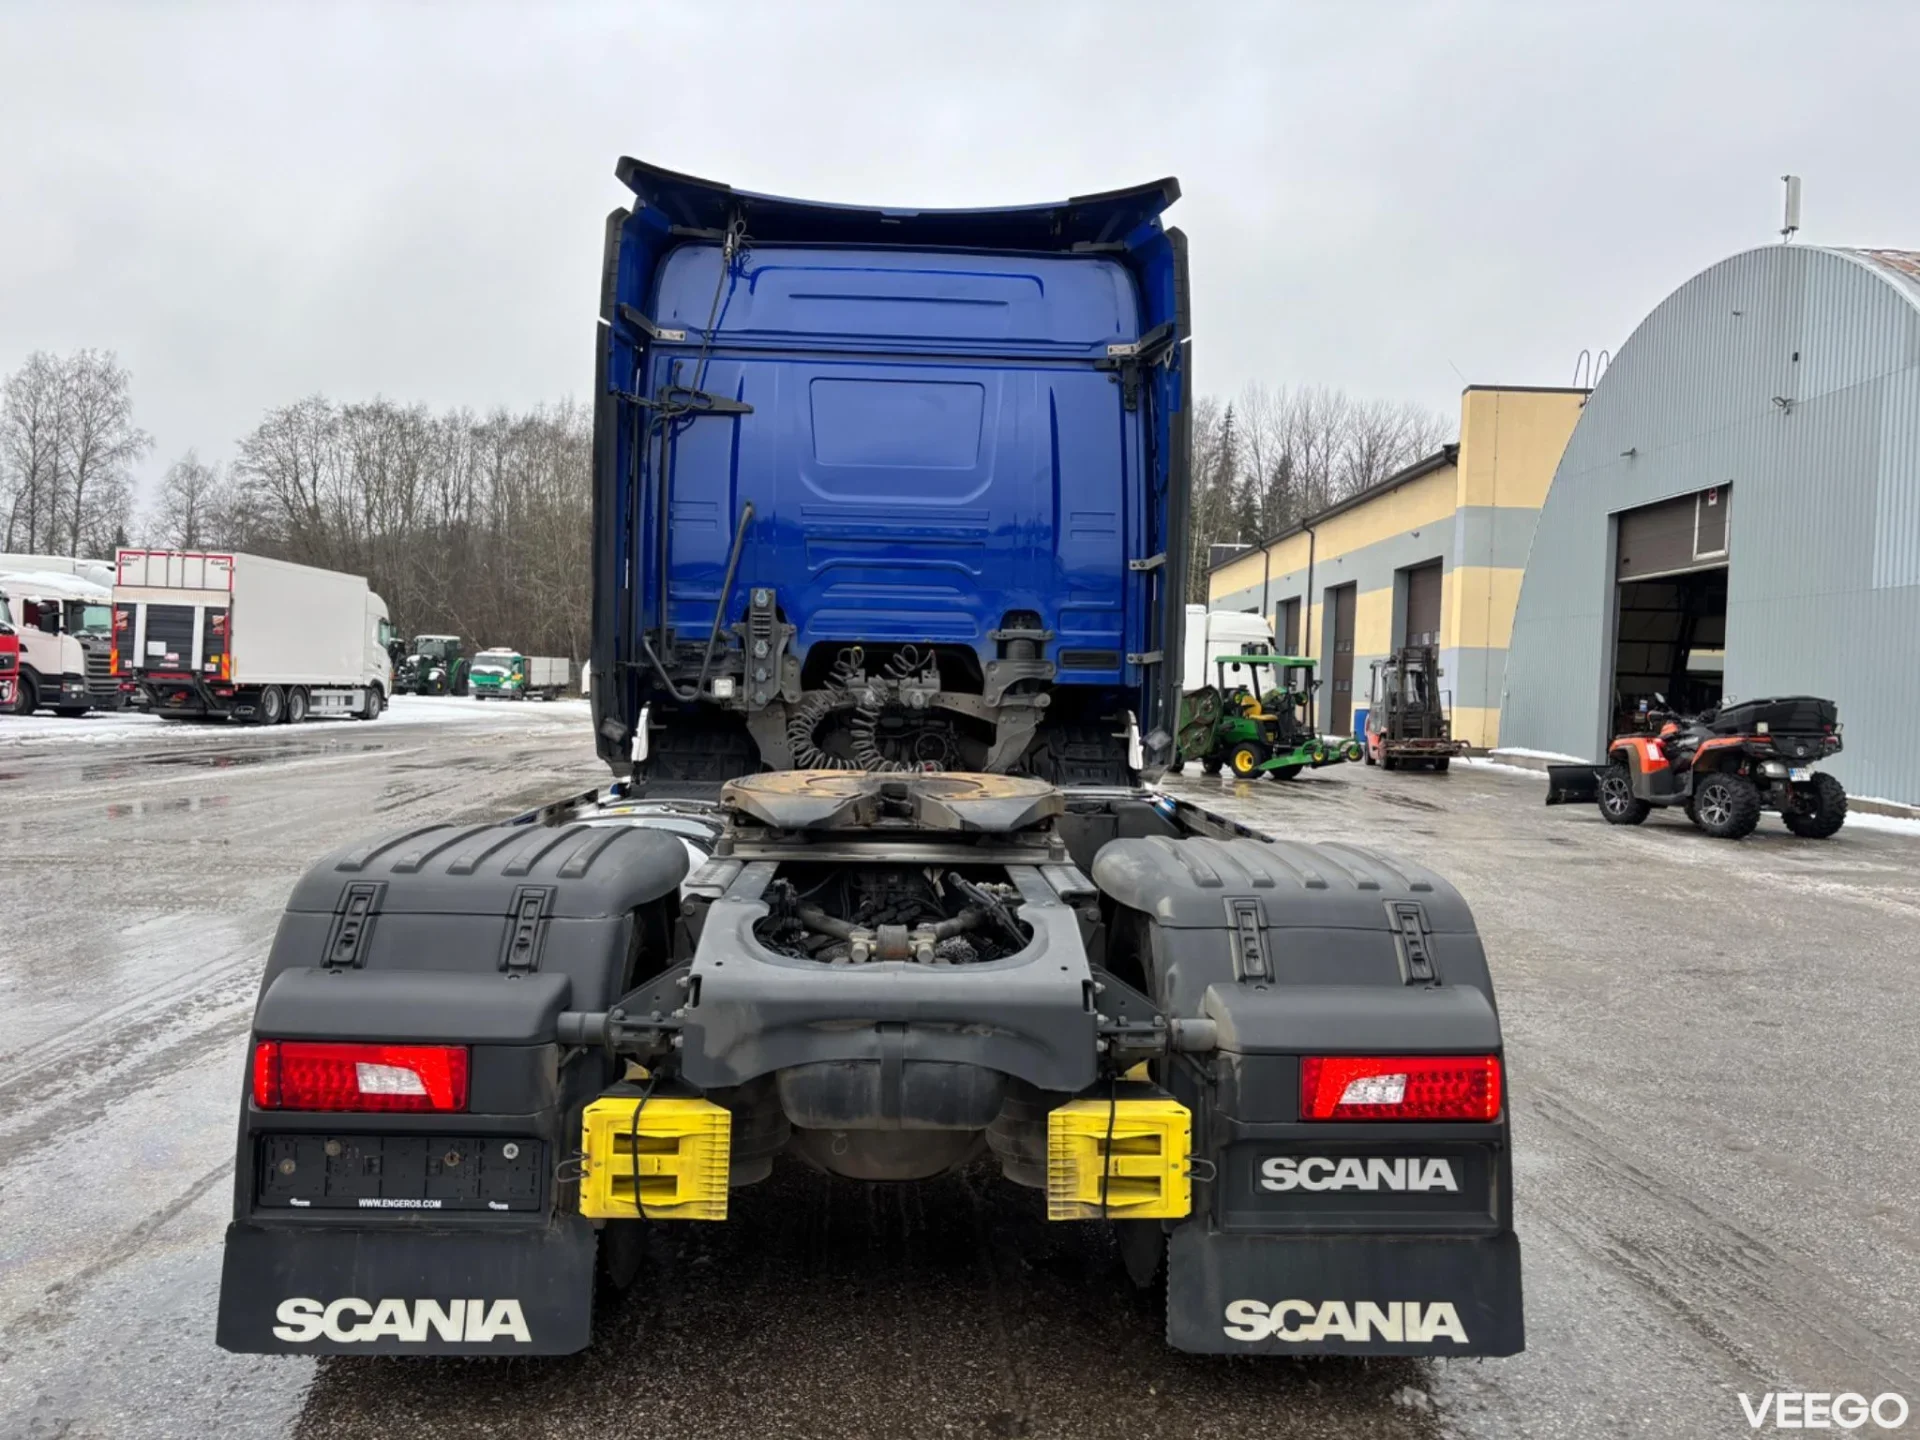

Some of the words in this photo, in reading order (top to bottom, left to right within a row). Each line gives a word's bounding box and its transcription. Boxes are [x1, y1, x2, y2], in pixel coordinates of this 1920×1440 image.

[1260, 1157, 1459, 1192] SCANIA
[358, 1198, 442, 1209] WWW.ENGEROS.COM
[272, 1297, 532, 1343] SCANIA
[1223, 1299, 1470, 1344] SCANIA
